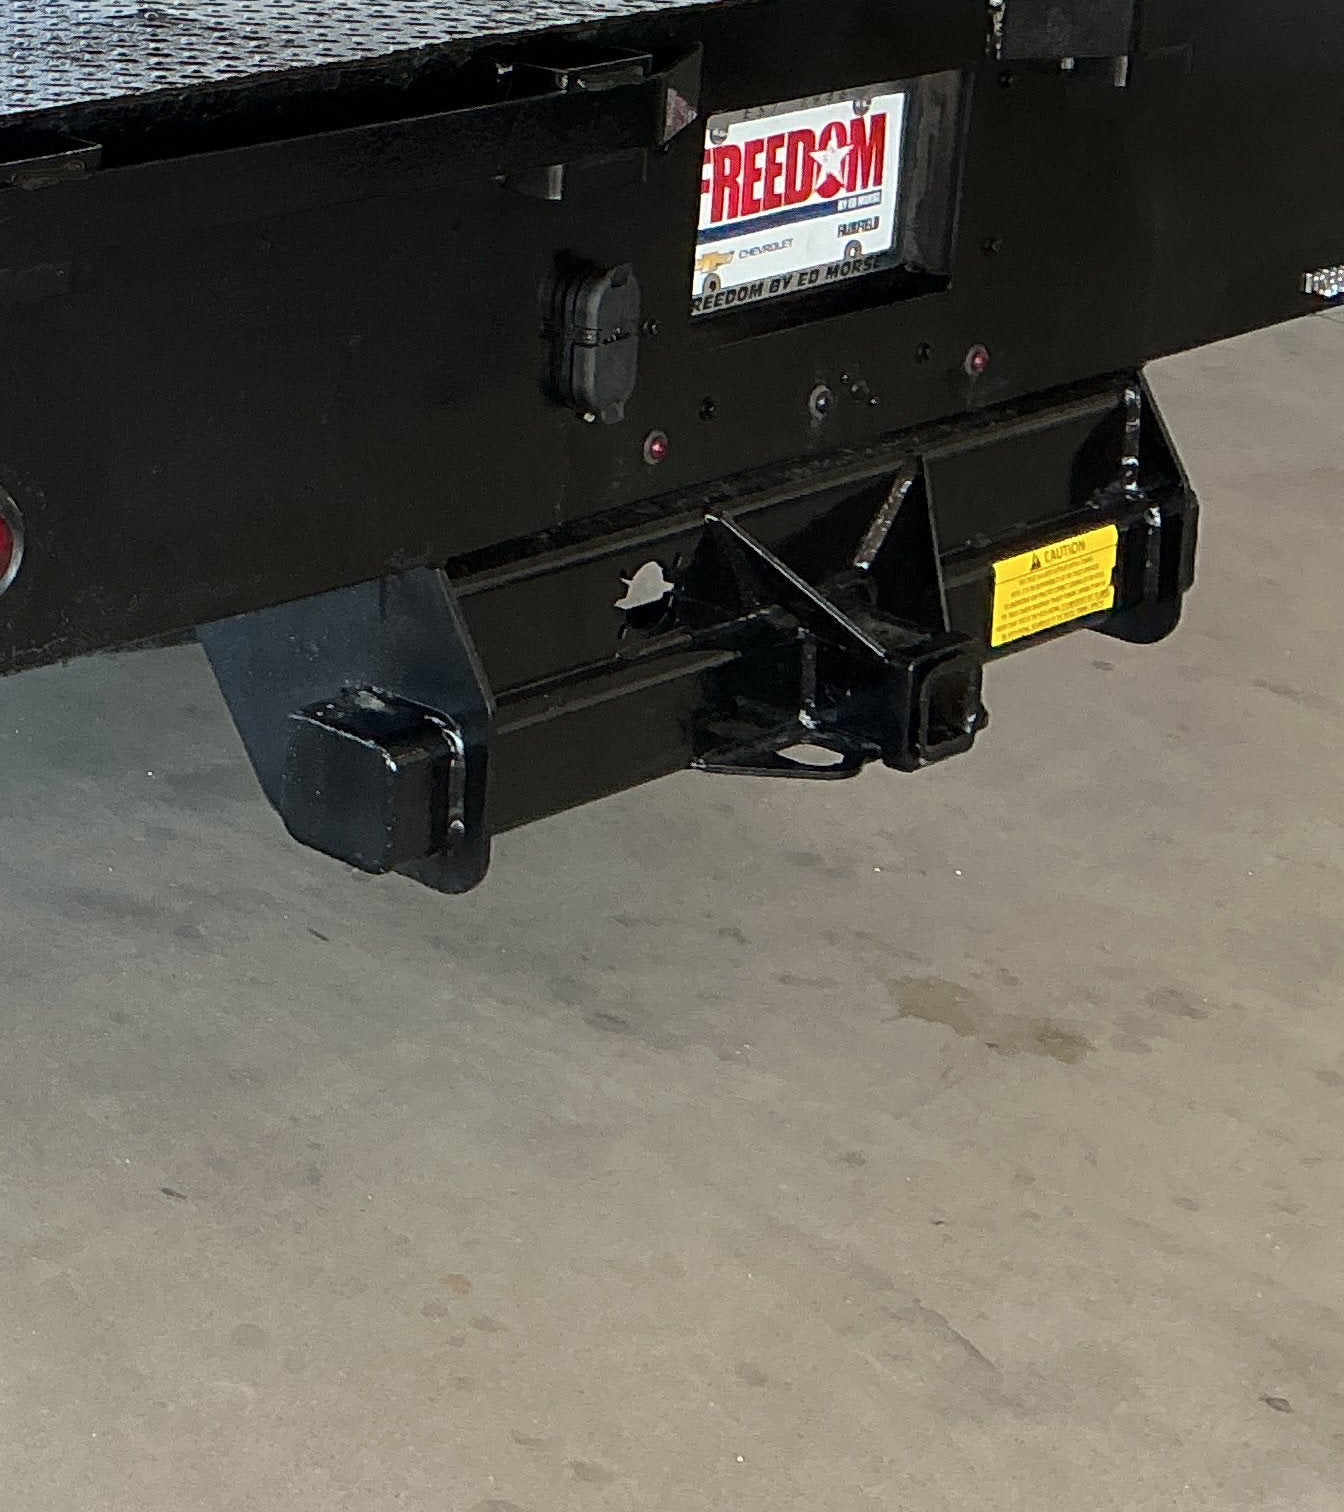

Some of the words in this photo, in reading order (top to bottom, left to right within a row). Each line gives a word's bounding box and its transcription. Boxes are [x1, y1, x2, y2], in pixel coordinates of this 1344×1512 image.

[738, 238, 794, 259] CHEVROLET
[691, 282, 763, 313] REEDOM
[768, 274, 792, 294] BY
[797, 268, 820, 287] ED
[1044, 539, 1087, 563] CAUTION
